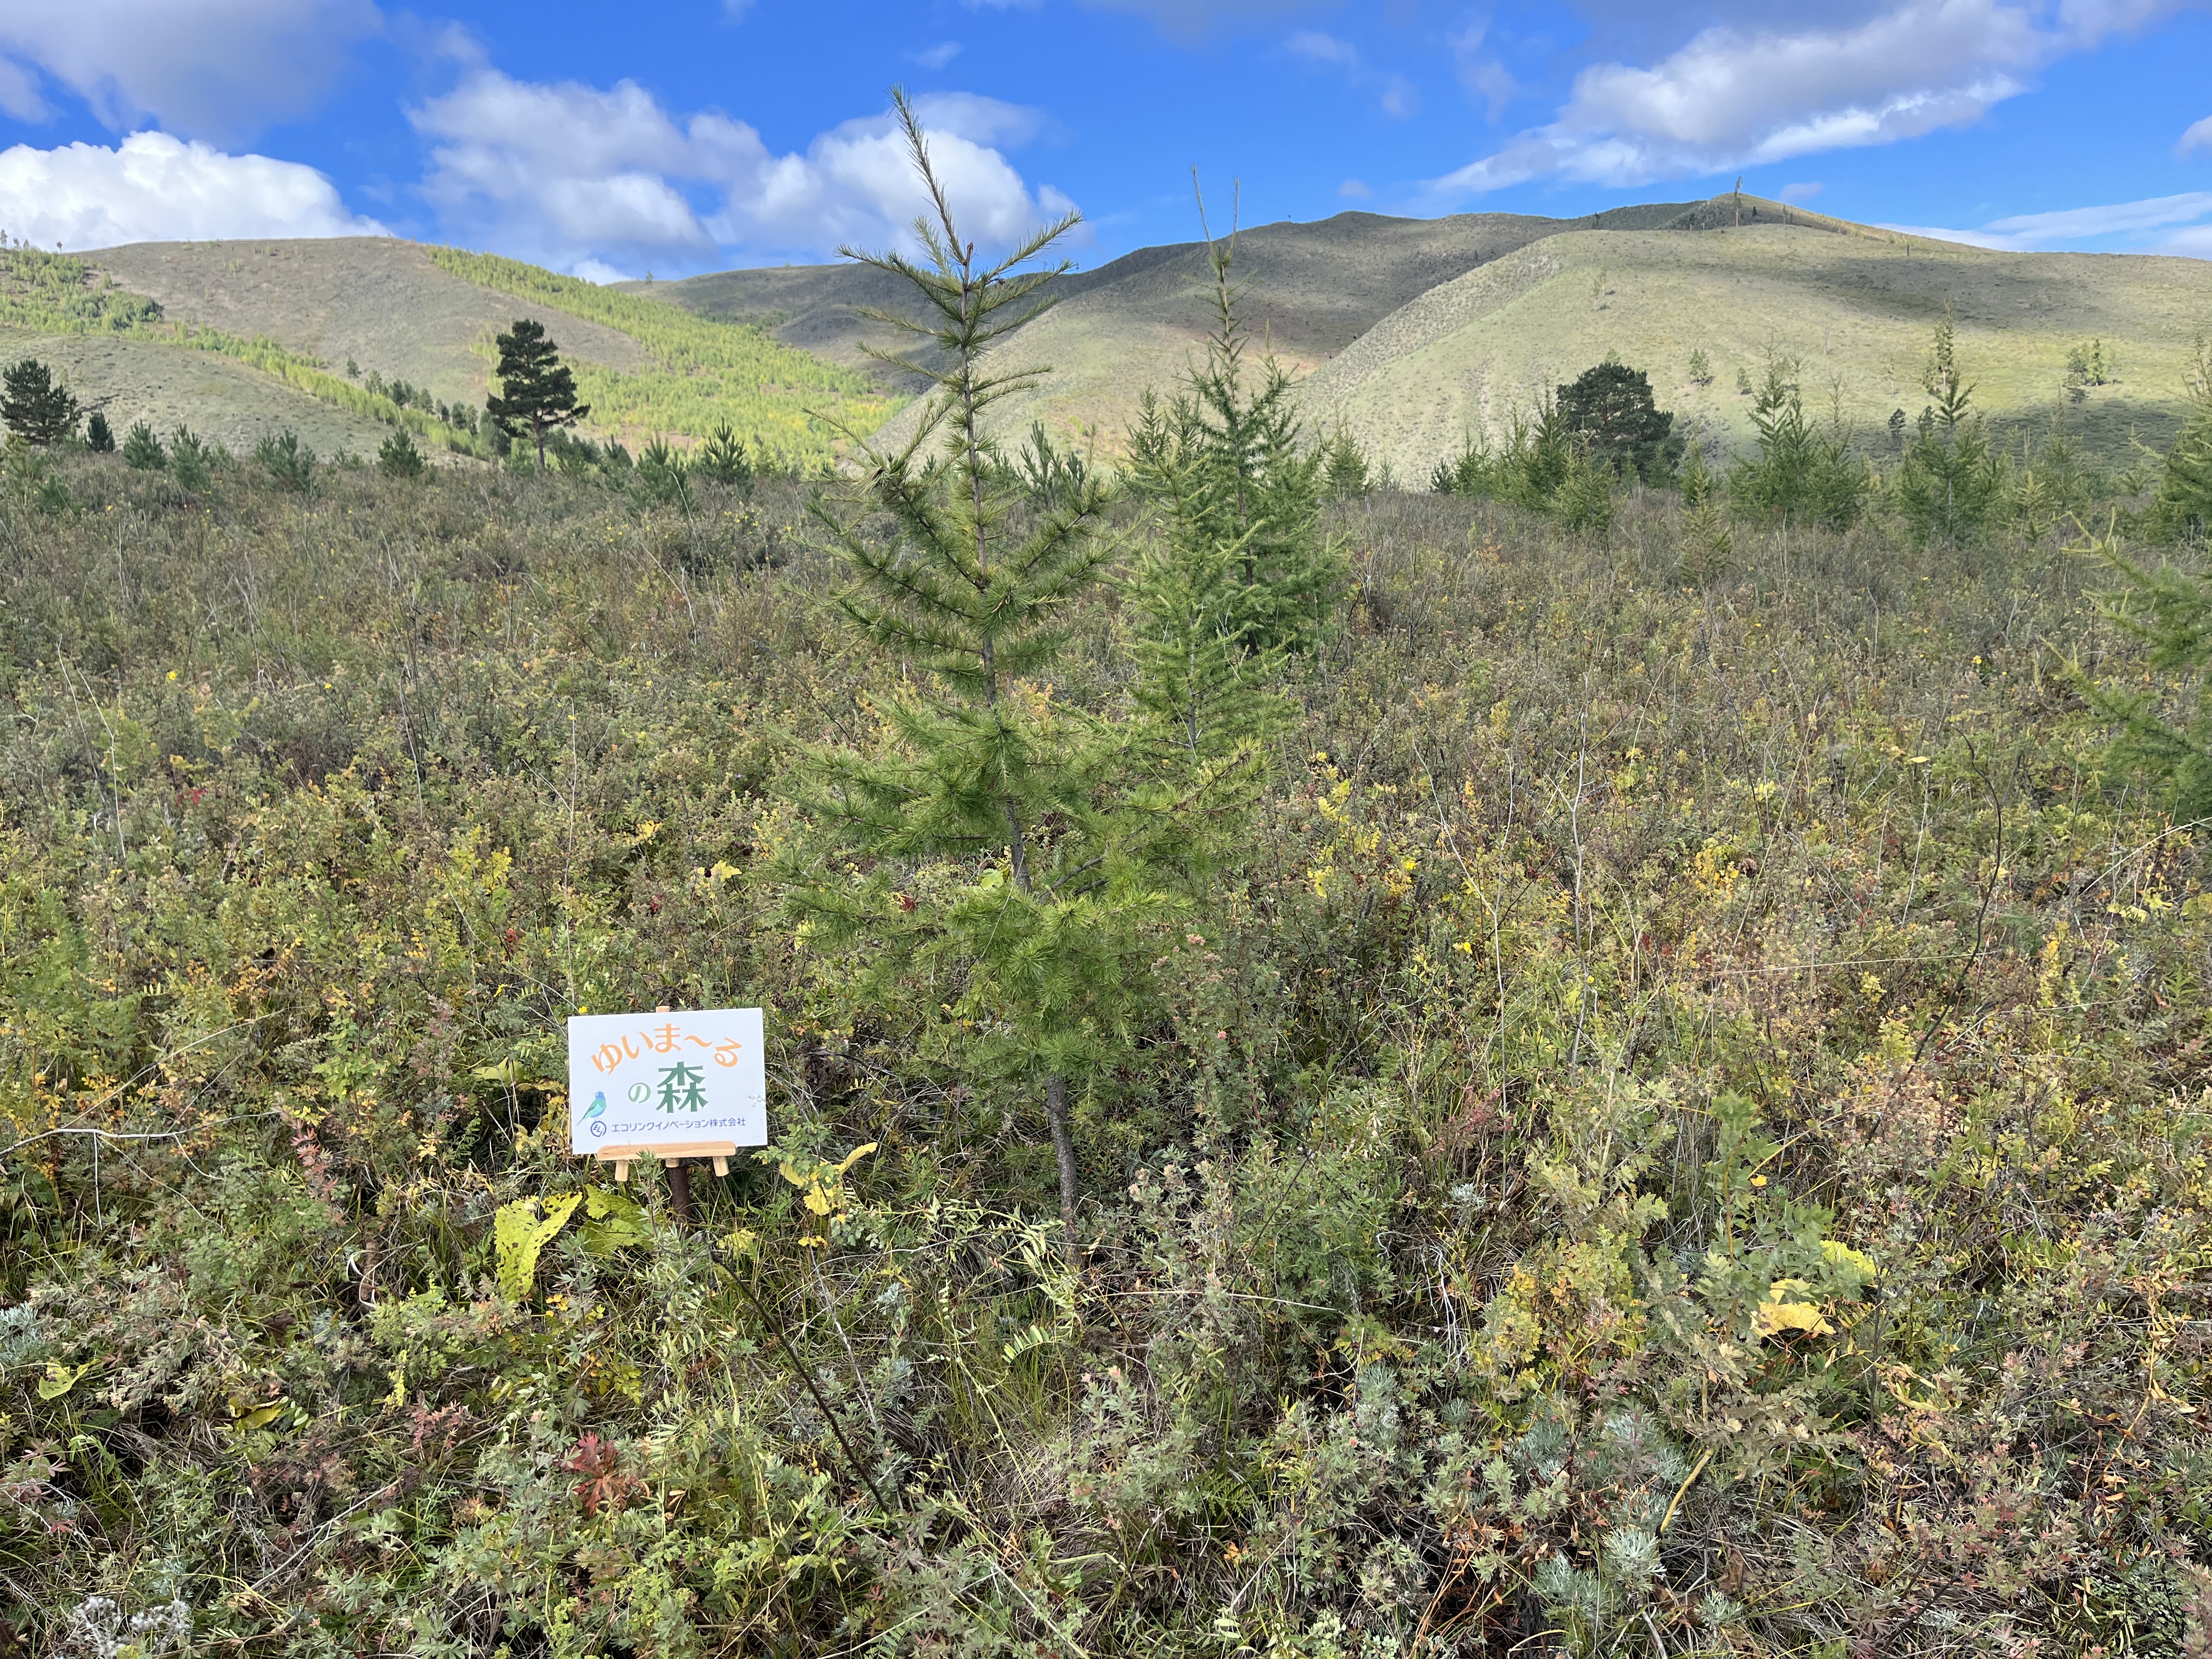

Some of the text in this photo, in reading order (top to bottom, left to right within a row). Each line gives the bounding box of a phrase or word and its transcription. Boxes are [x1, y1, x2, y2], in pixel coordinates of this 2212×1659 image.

[628, 1061, 709, 1113] の森
[612, 1117, 746, 1132] エコリンクイノベーション株式会社
